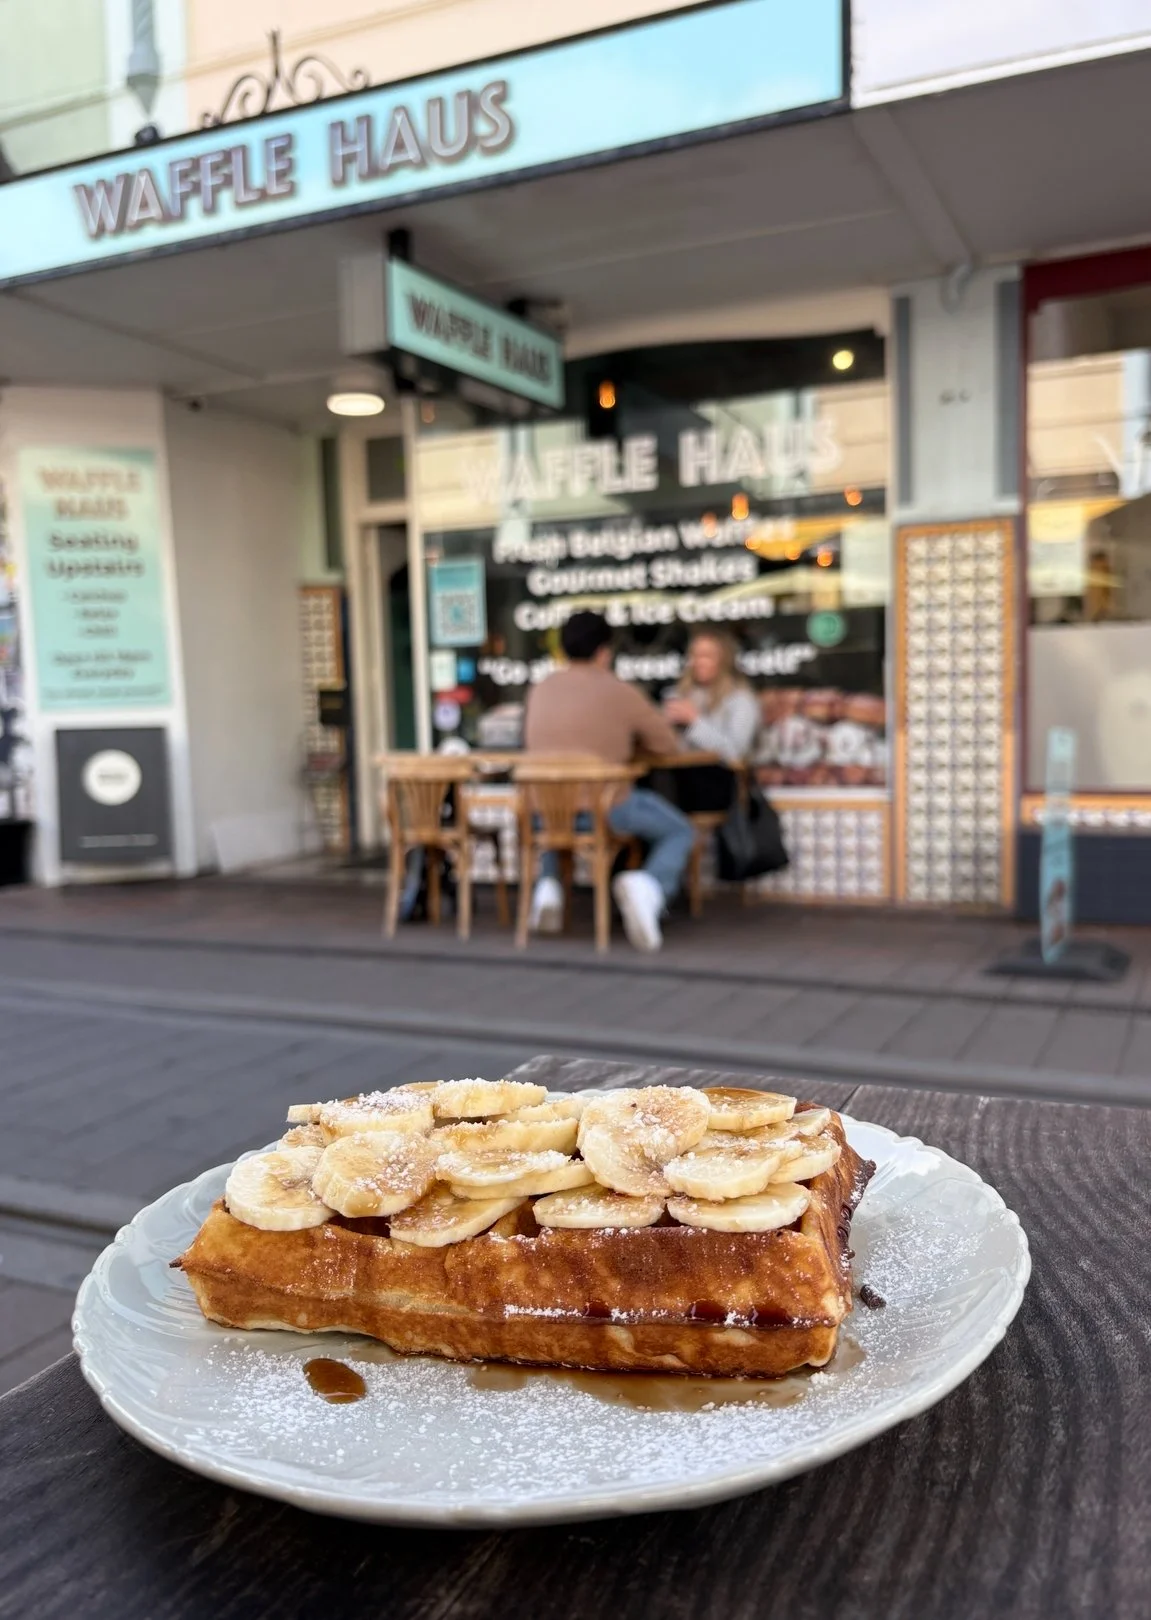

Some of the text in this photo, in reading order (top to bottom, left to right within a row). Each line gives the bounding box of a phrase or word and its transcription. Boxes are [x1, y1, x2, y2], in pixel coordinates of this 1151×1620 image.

[74, 80, 516, 239] WAFFLE HAUS
[406, 291, 491, 364] WAFFLE
[462, 417, 843, 504] WAFFLE HAUS
[46, 528, 140, 556] Seating
[569, 524, 680, 561] Belgian
[44, 556, 146, 583] Upstairs
[526, 551, 758, 597] Gourmet Shakes
[605, 599, 630, 627] &
[631, 595, 676, 625] Ice
[676, 592, 775, 623] Cream
